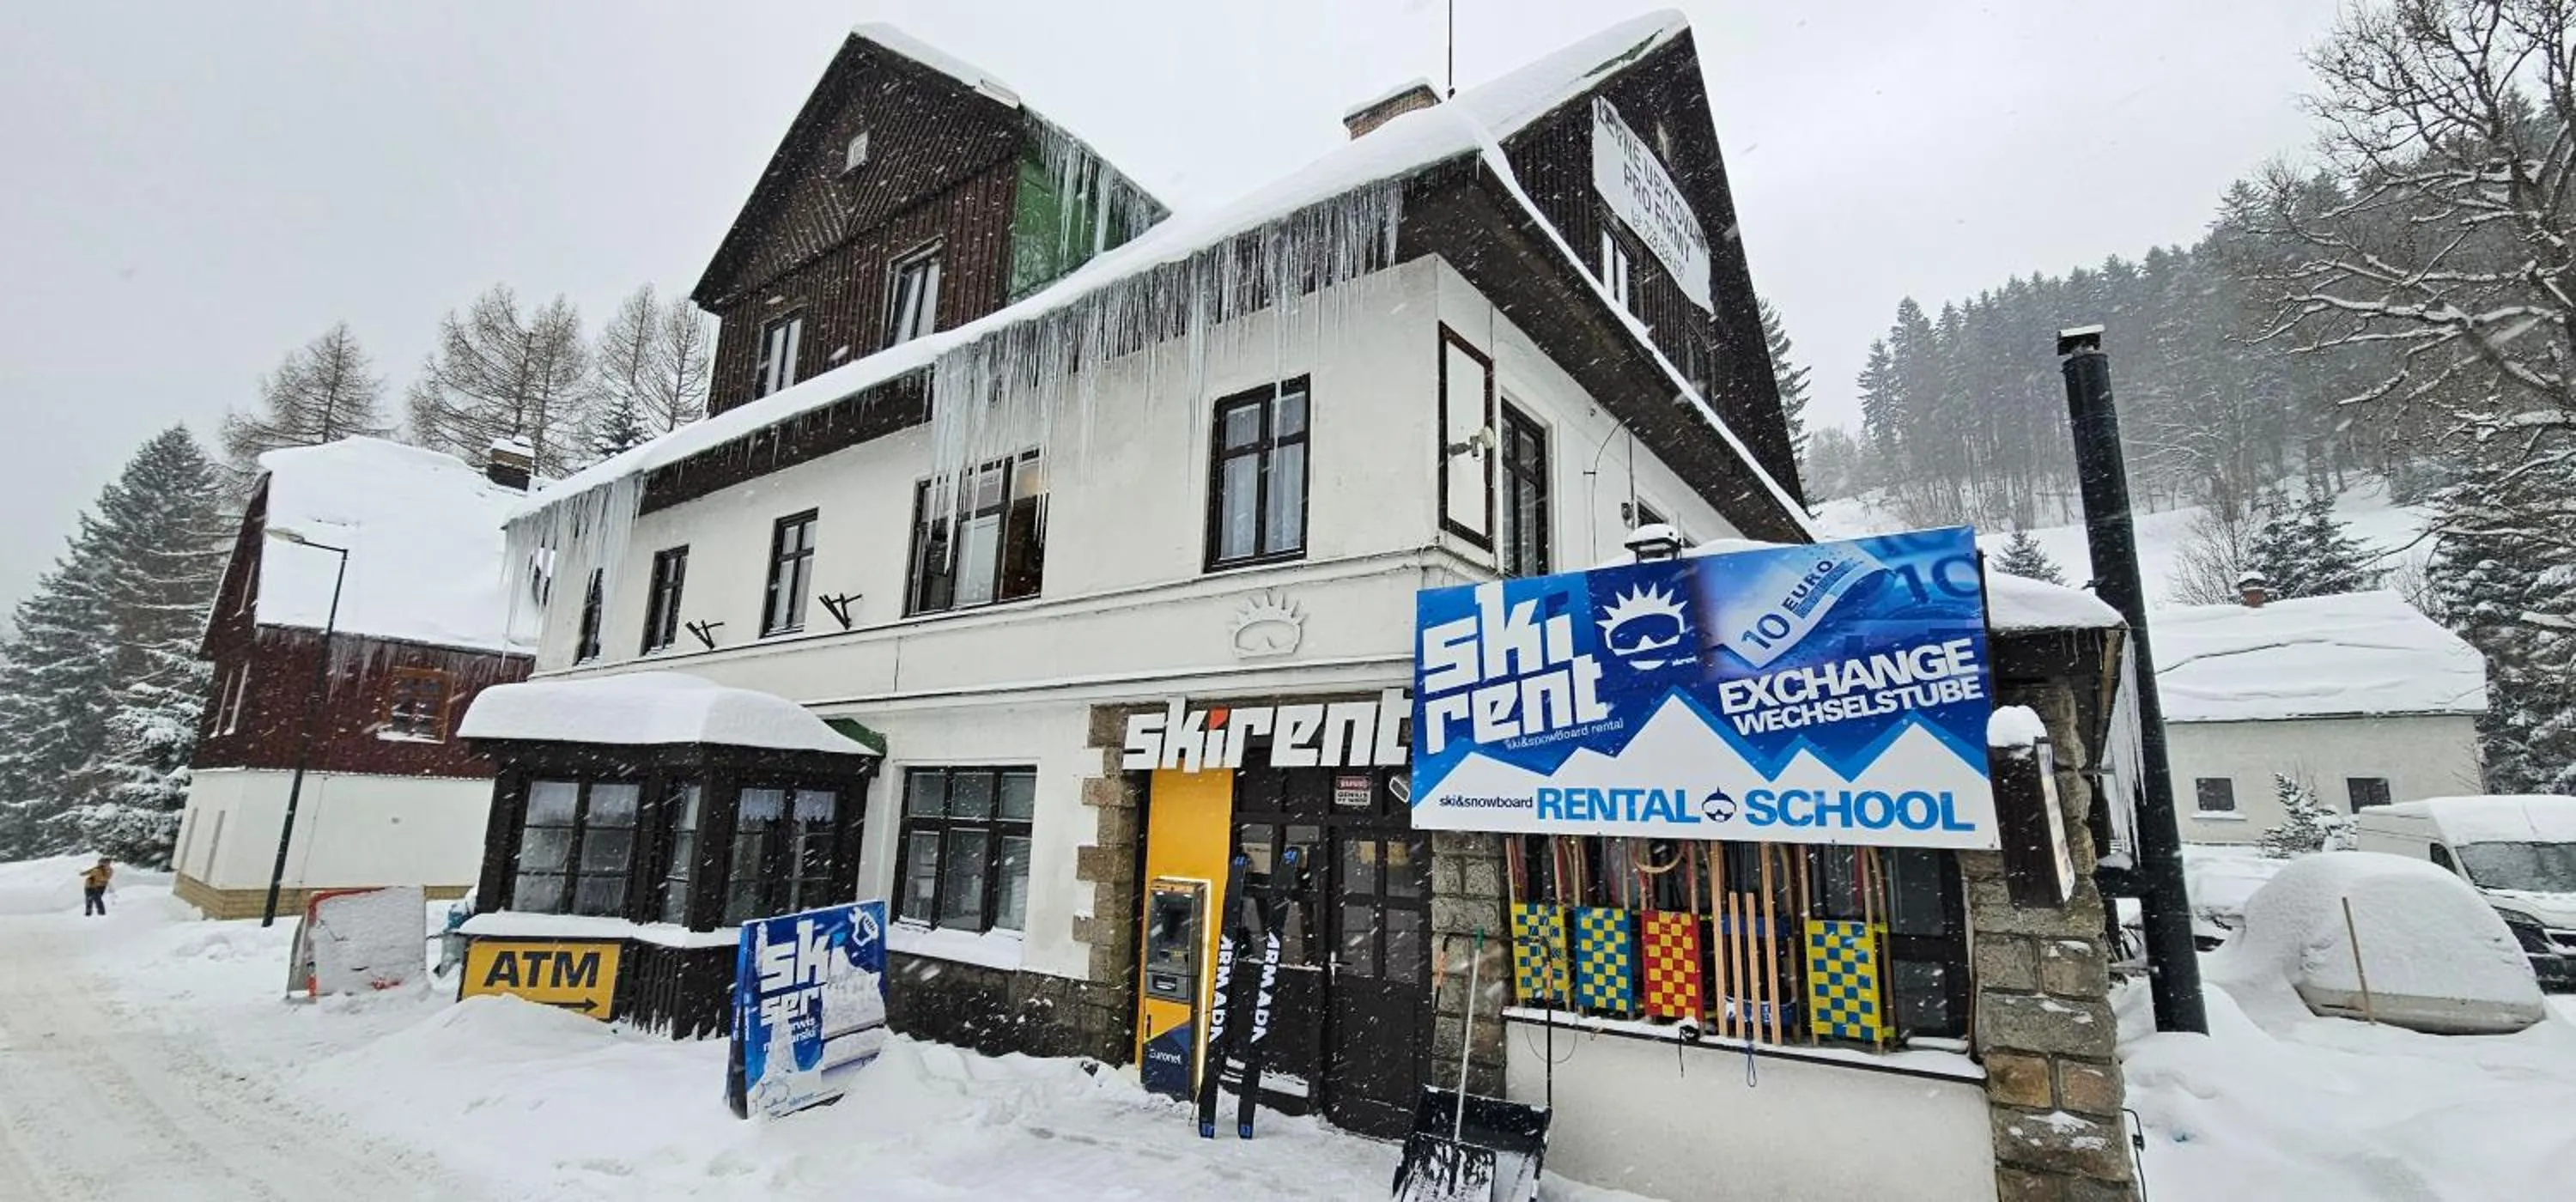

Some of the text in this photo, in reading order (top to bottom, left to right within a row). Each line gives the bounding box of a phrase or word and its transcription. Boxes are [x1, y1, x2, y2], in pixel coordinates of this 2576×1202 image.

[1624, 161, 1651, 213] PRO
[1423, 580, 1574, 694] ski
[1741, 561, 1833, 650] 10 EURO
[1426, 653, 1609, 755] rent
[1718, 638, 1979, 714] EXCHANGE
[1732, 676, 1984, 736] WECHSELSTUBE
[1122, 689, 1413, 773] skirent
[1591, 718, 1624, 733] rental
[1439, 787, 1976, 833] ski&snowboard RENTAL SCHOOL
[483, 950, 601, 988] ATM
[1209, 934, 1235, 1043] ARMADA
[1250, 931, 1280, 1044] ARMADA
